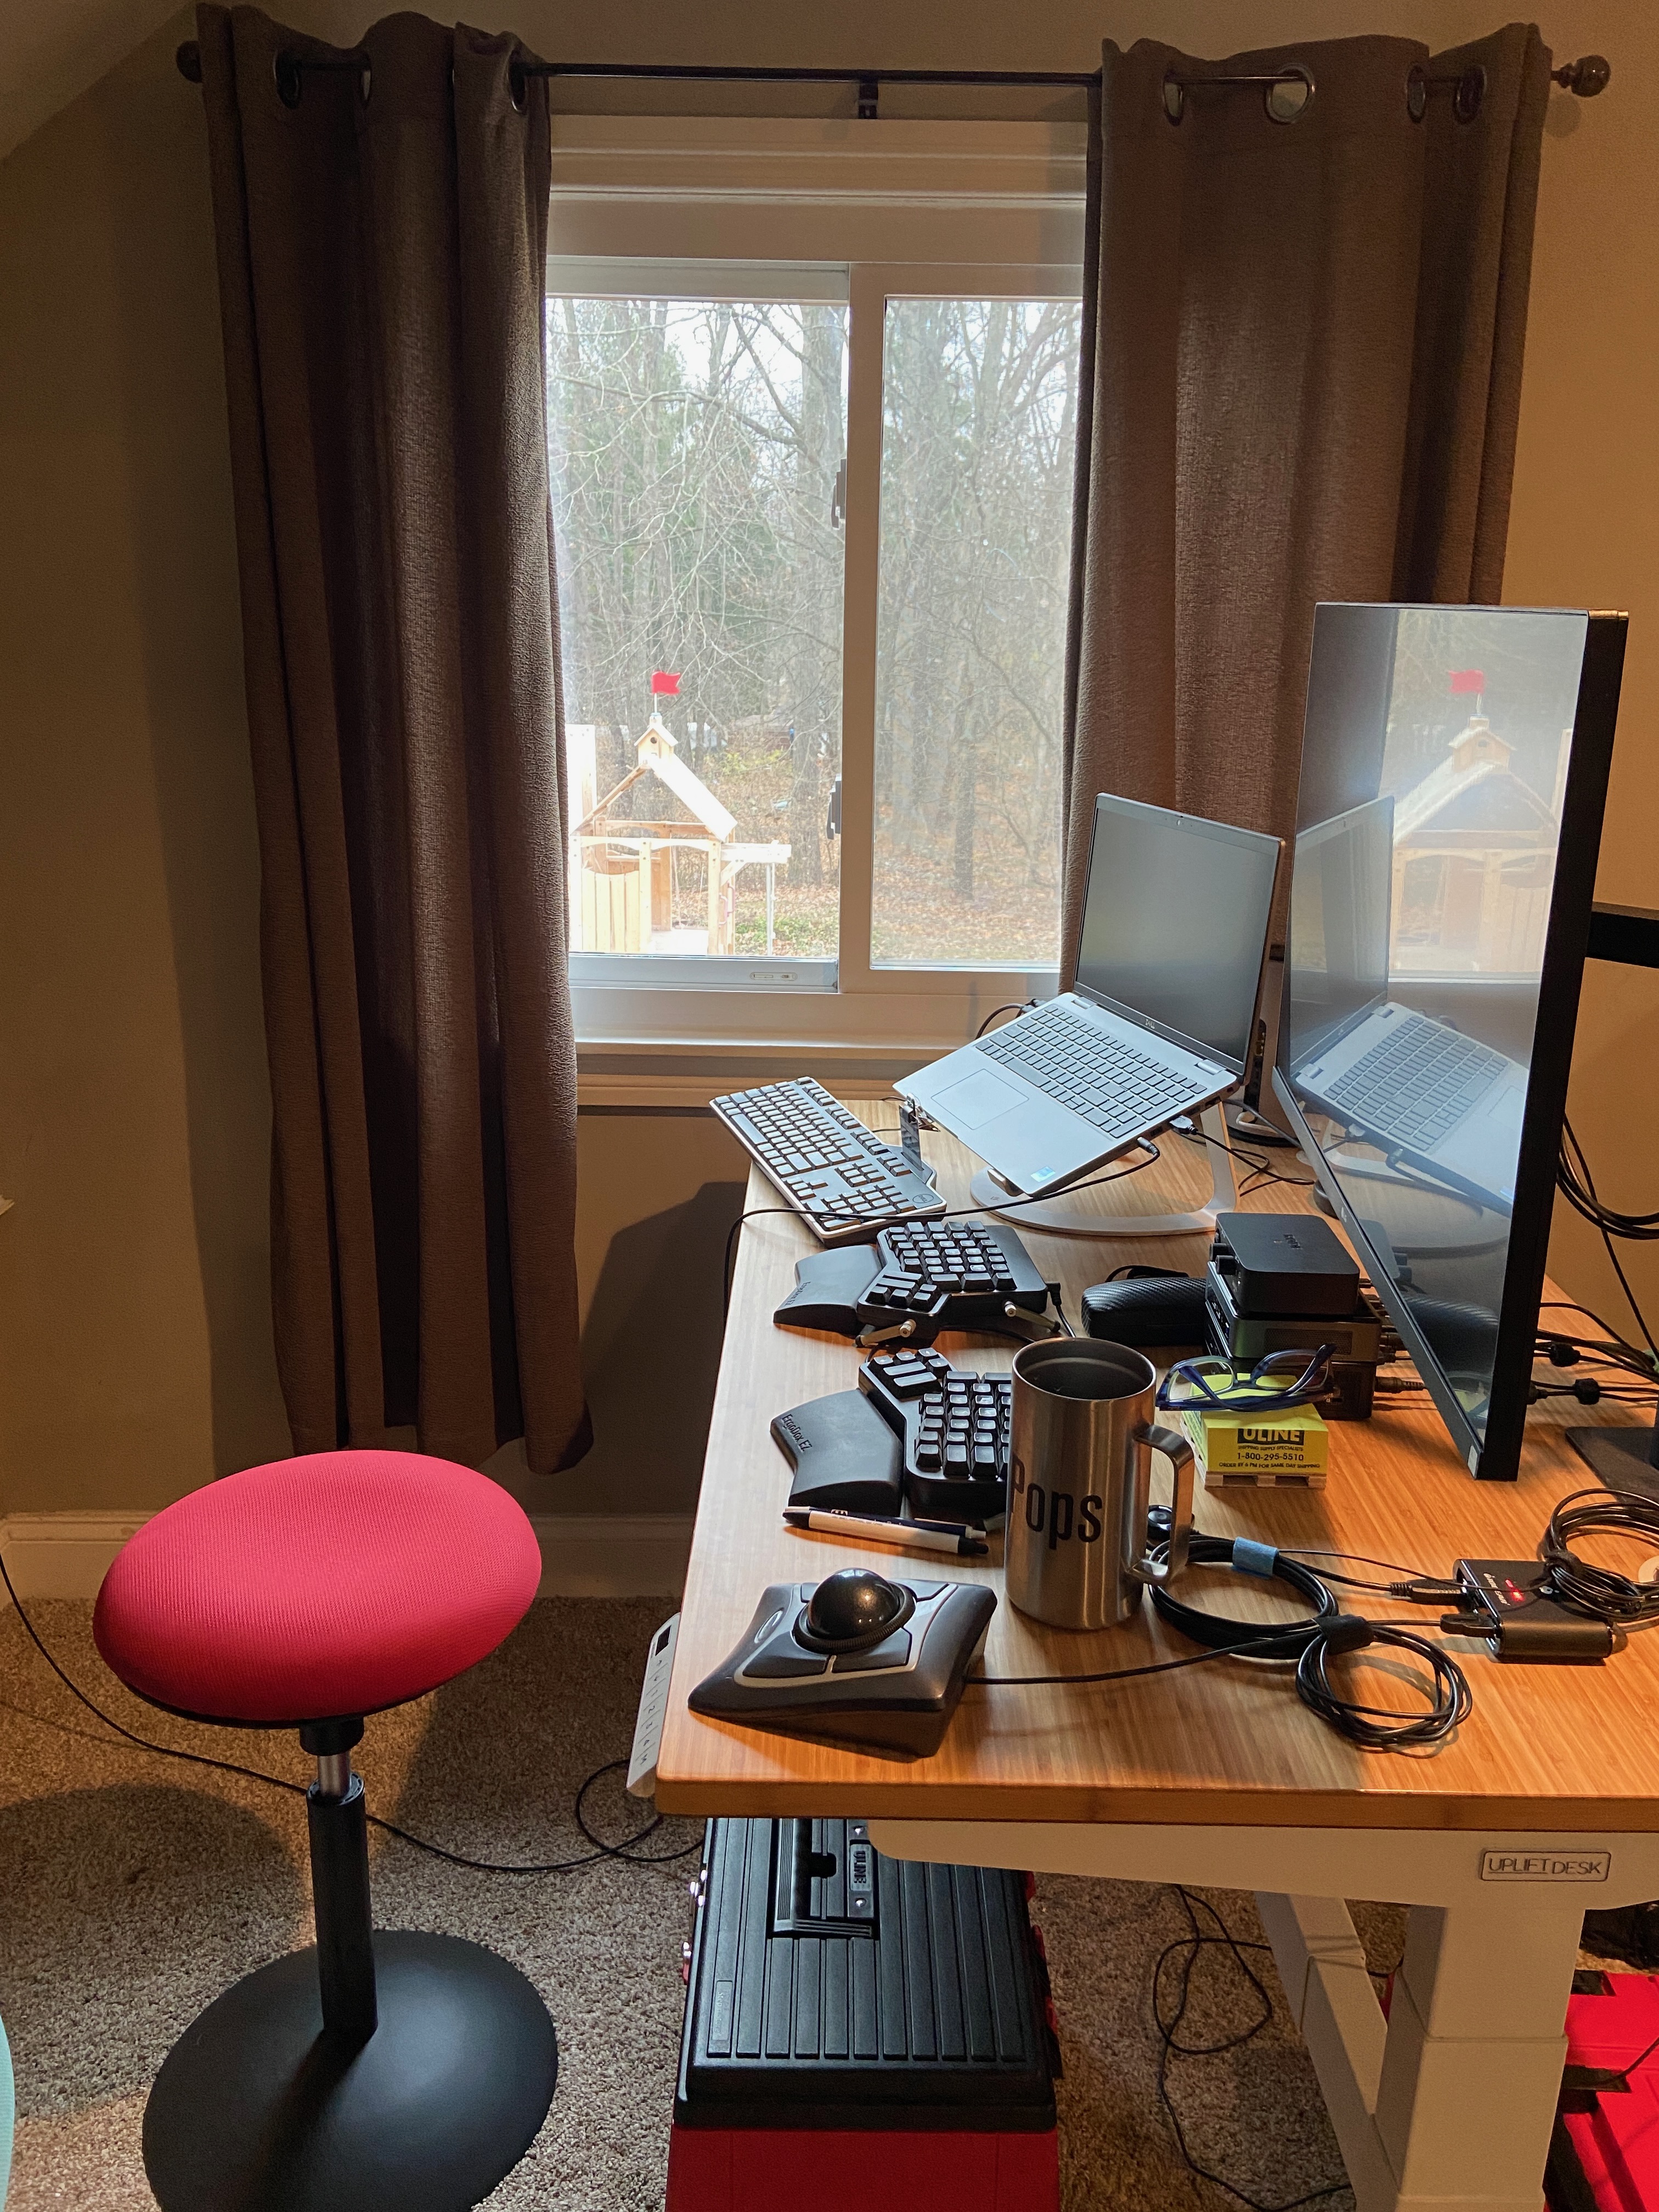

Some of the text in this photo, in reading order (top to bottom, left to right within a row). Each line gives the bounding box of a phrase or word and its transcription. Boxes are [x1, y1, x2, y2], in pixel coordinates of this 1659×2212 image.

[782, 1414, 812, 1452] ErgoDox EZ
[1243, 1429, 1300, 1442] ULINE
[1237, 1453, 1304, 1461] 1-800-295-5510
[1011, 1454, 1102, 1550] Pops
[648, 1705, 655, 1714] 2
[853, 1850, 867, 1883] ULINE
[1488, 1858, 1602, 1875] UPLIFT DESK
